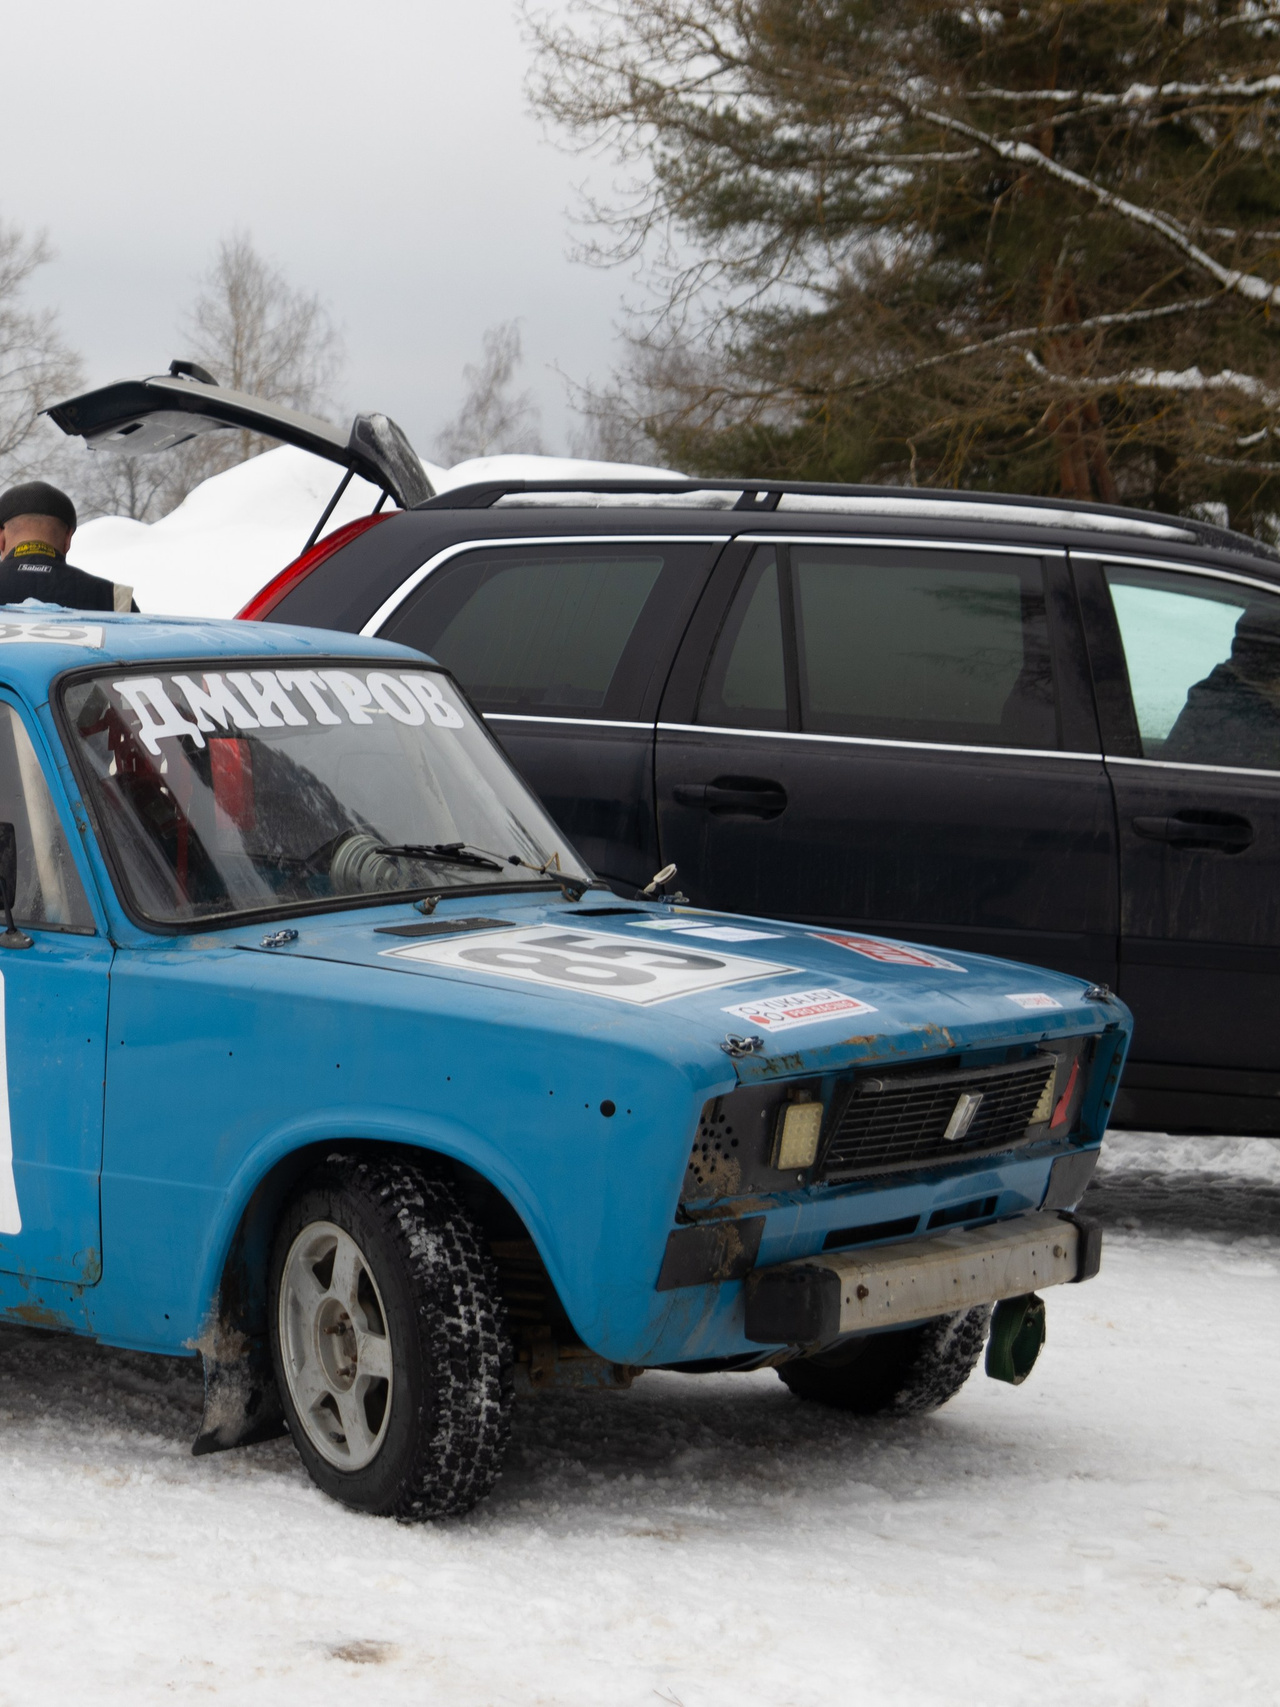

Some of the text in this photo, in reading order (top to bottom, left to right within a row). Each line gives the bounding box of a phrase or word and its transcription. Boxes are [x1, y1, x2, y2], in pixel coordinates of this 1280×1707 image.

[112, 670, 464, 756] ДМИТРОВ
[458, 934, 726, 986] 85
[757, 996, 806, 1010] YUKA
